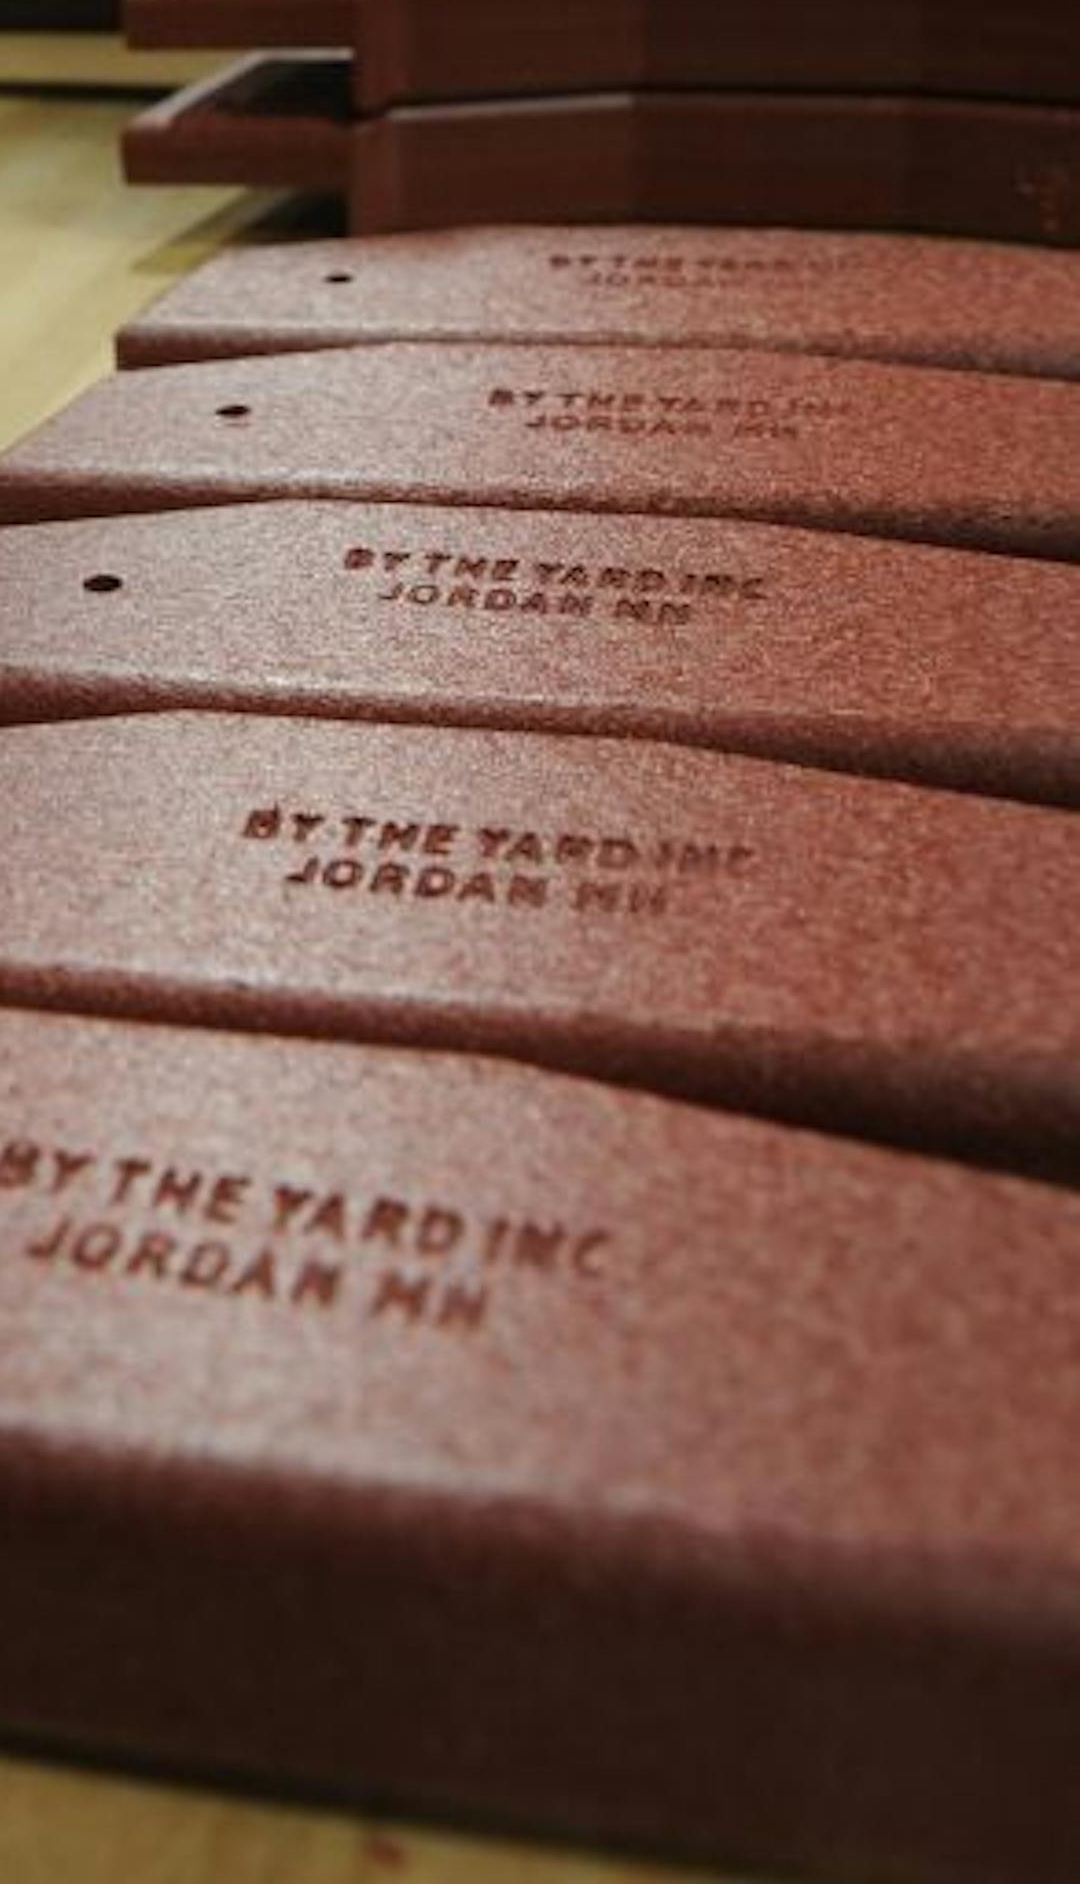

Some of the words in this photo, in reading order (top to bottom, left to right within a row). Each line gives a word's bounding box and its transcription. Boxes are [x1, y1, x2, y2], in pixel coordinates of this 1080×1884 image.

[488, 388, 544, 407] BY
[343, 547, 410, 571] BY
[425, 552, 519, 582] THE
[535, 562, 665, 592] YARD
[379, 583, 593, 616] JORDAN
[242, 804, 324, 840] BY
[340, 815, 459, 855] THE
[476, 827, 636, 869] YARD
[285, 857, 548, 908] JORDAN
[112, 1154, 249, 1222] THE
[270, 1184, 464, 1256] YARD
[482, 1220, 613, 1278] INC
[26, 1219, 340, 1309] JORDAN
[374, 1273, 489, 1329] MN
